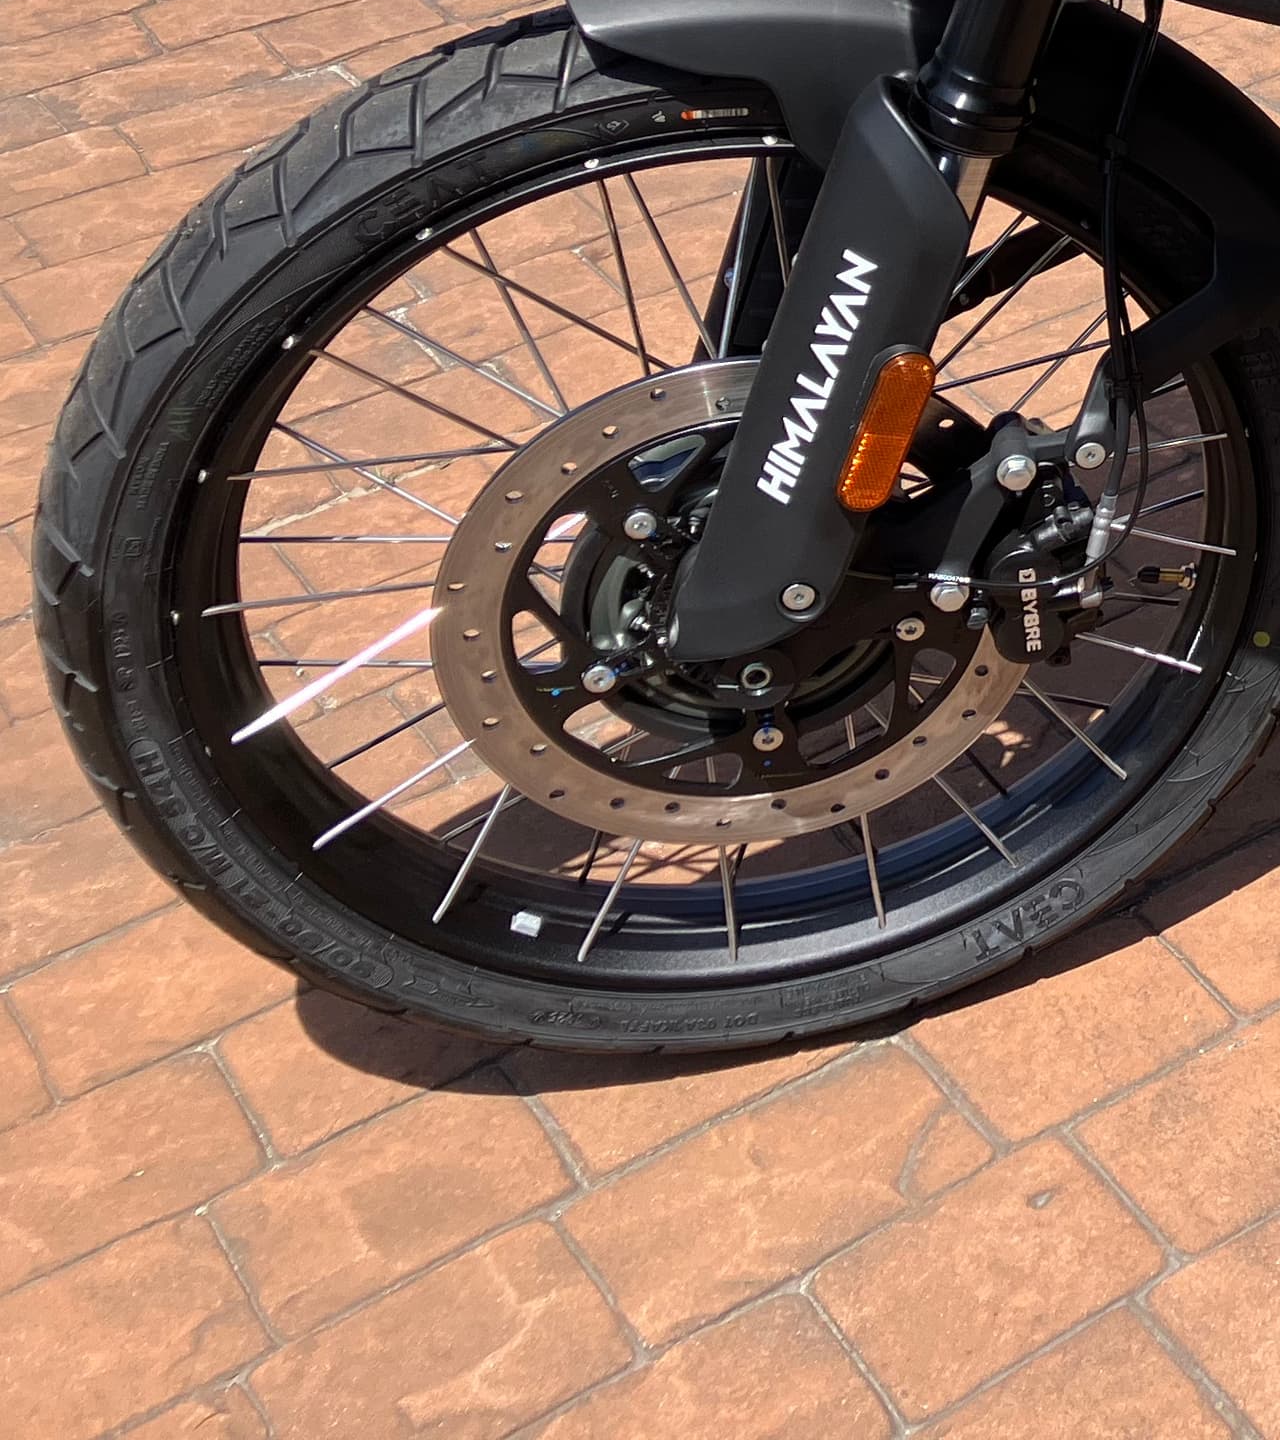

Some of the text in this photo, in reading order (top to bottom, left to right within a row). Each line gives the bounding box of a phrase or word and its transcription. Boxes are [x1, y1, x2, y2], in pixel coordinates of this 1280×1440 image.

[756, 248, 879, 505] HIMALAYAN
[1020, 587, 1043, 653] BYBRE
[971, 877, 1086, 962] CEAT
